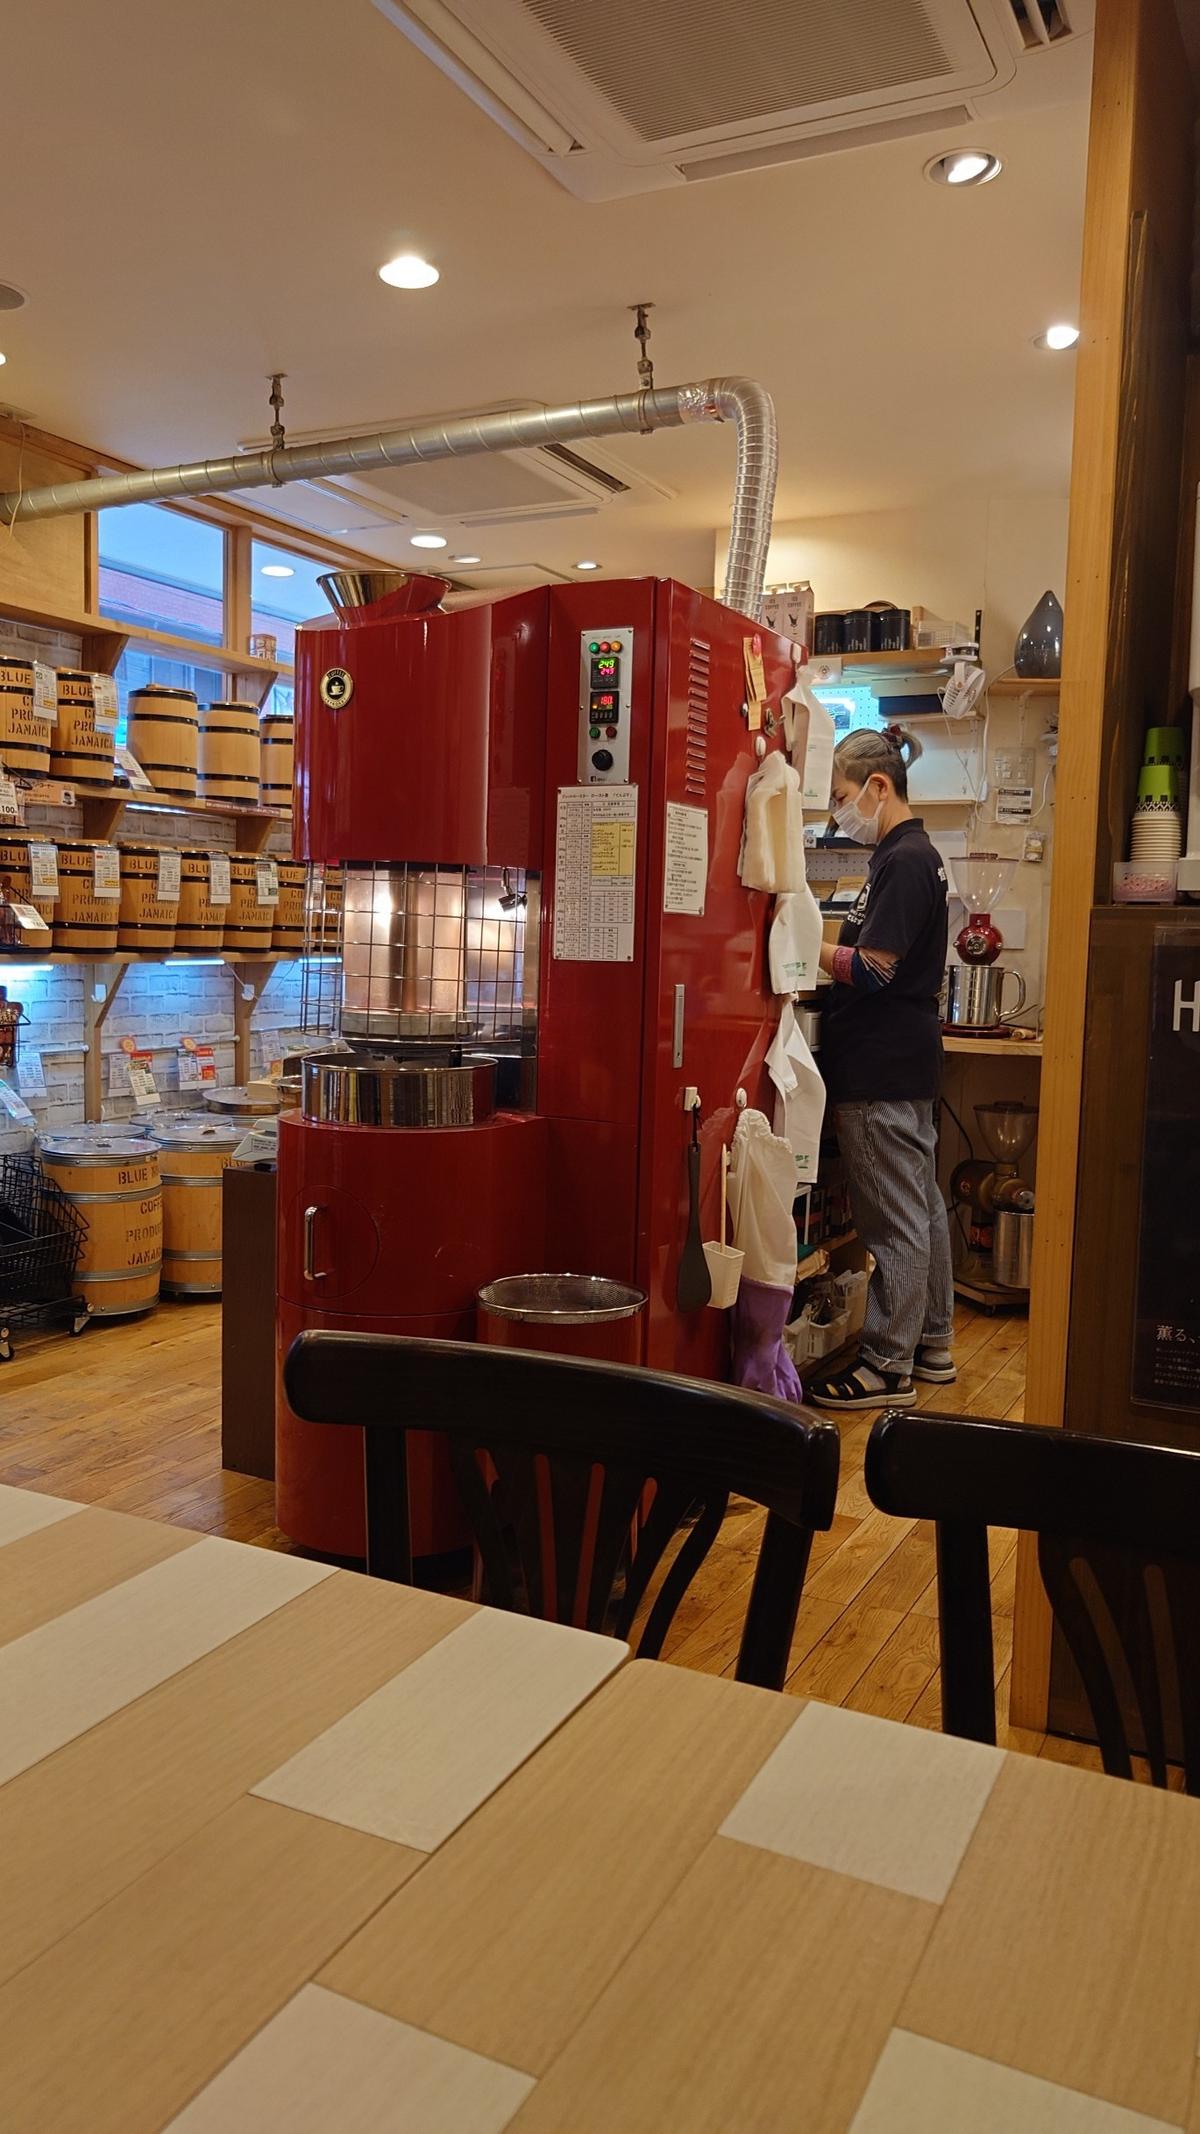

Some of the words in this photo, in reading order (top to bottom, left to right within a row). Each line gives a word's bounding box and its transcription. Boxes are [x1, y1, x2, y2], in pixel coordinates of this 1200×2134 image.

[189, 863, 209, 874] BLU
[118, 1168, 148, 1185] BLUE
[1156, 1325, 1200, 1344] 薫る、
